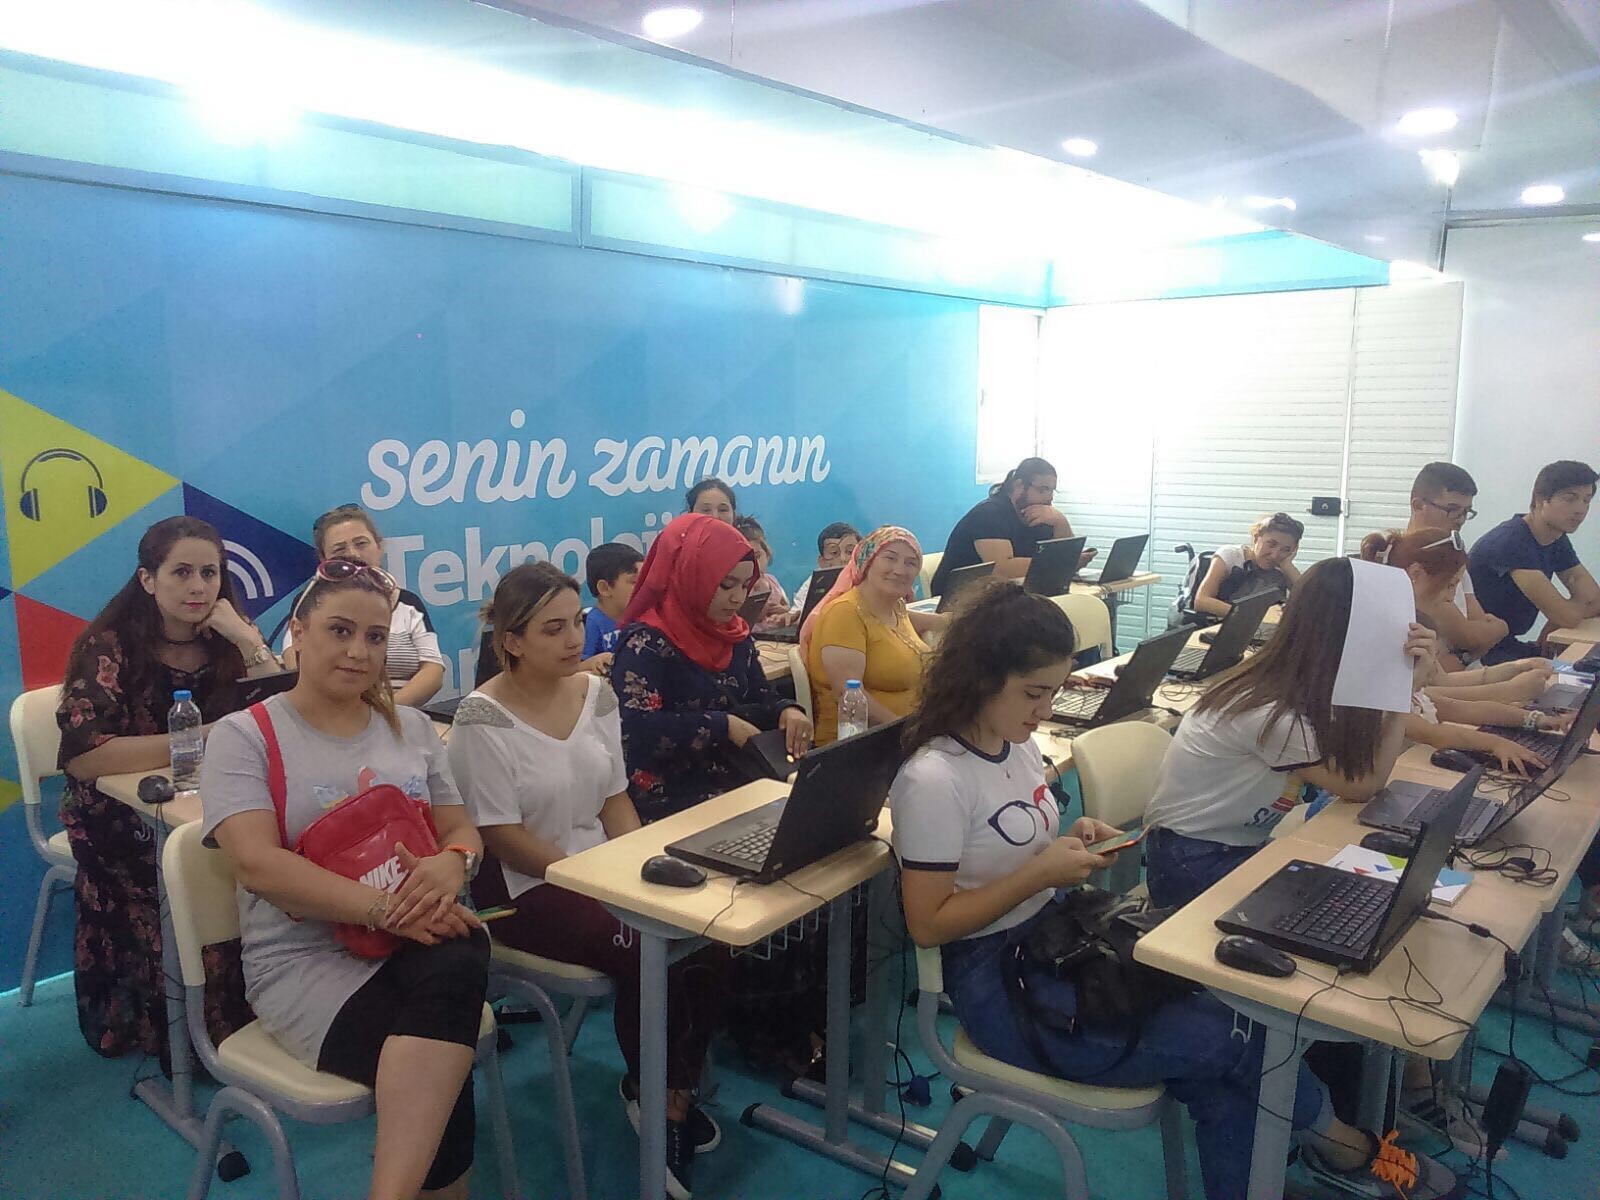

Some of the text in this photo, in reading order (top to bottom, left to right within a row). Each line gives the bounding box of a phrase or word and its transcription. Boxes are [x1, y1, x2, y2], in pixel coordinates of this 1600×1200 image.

[361, 409, 830, 511] senin zamanın
[382, 512, 673, 606] Tekno
[359, 855, 403, 890] NIKE
